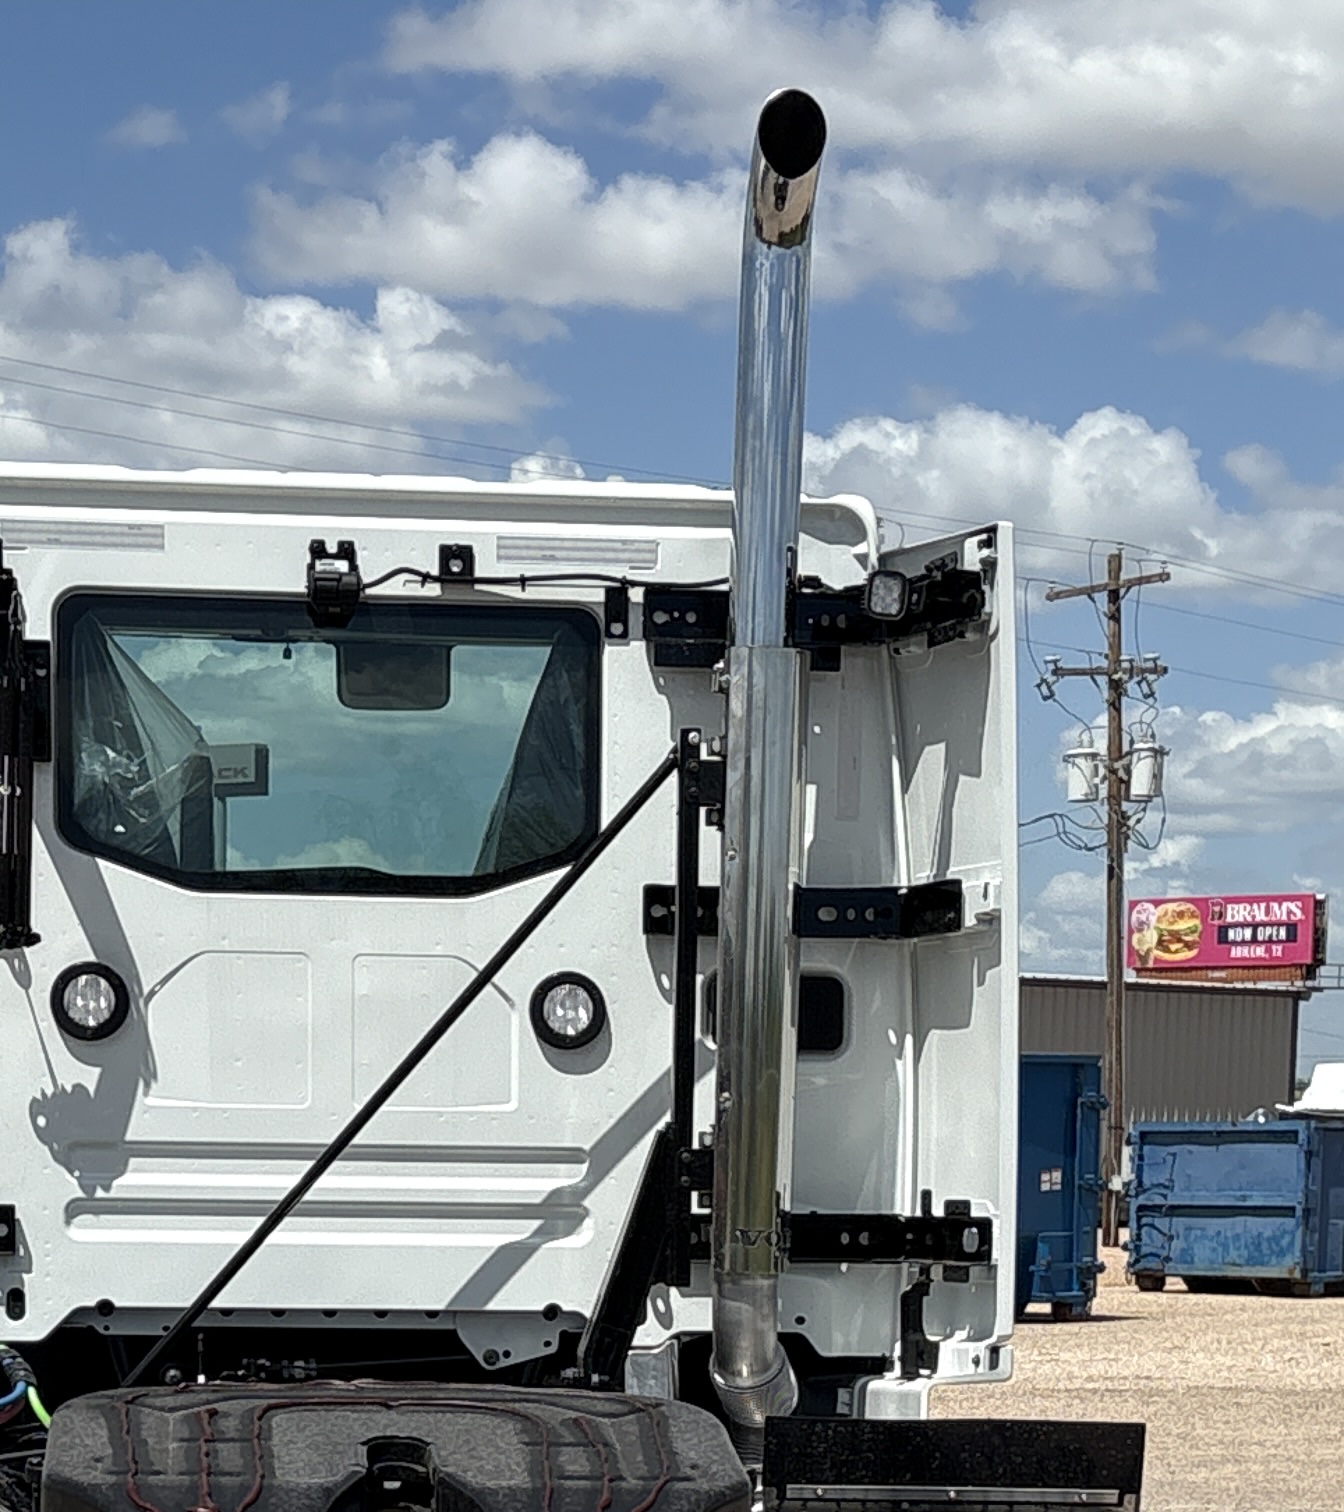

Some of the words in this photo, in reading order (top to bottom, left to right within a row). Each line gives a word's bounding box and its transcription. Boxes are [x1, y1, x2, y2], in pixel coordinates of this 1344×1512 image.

[1225, 901, 1303, 922] BRAUM'S
[1227, 926, 1253, 942] NOW
[1257, 925, 1287, 942] OPEN
